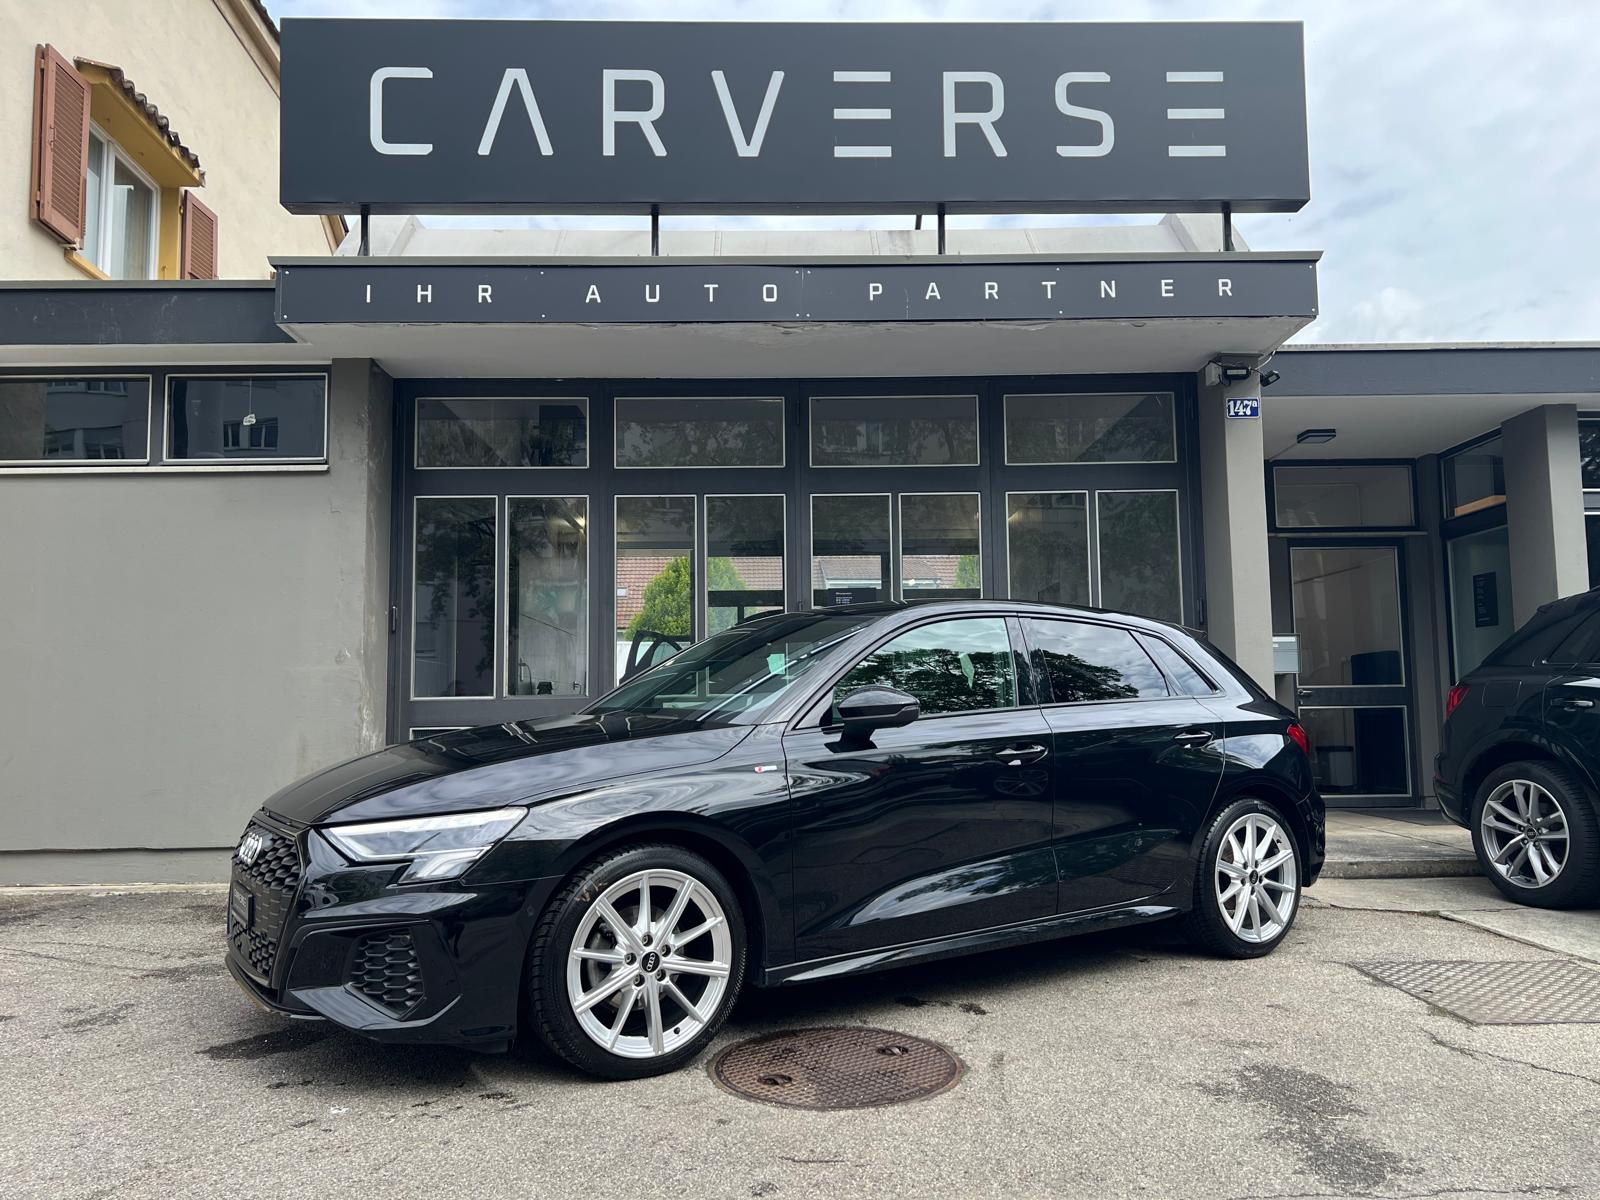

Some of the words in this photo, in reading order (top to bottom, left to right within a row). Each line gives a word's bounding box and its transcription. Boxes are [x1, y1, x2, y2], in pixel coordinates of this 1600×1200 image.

[370, 66, 1227, 158] CARVERSE
[366, 284, 492, 303] IHR
[585, 283, 778, 303] AUTO
[869, 278, 1233, 301] PARTNER
